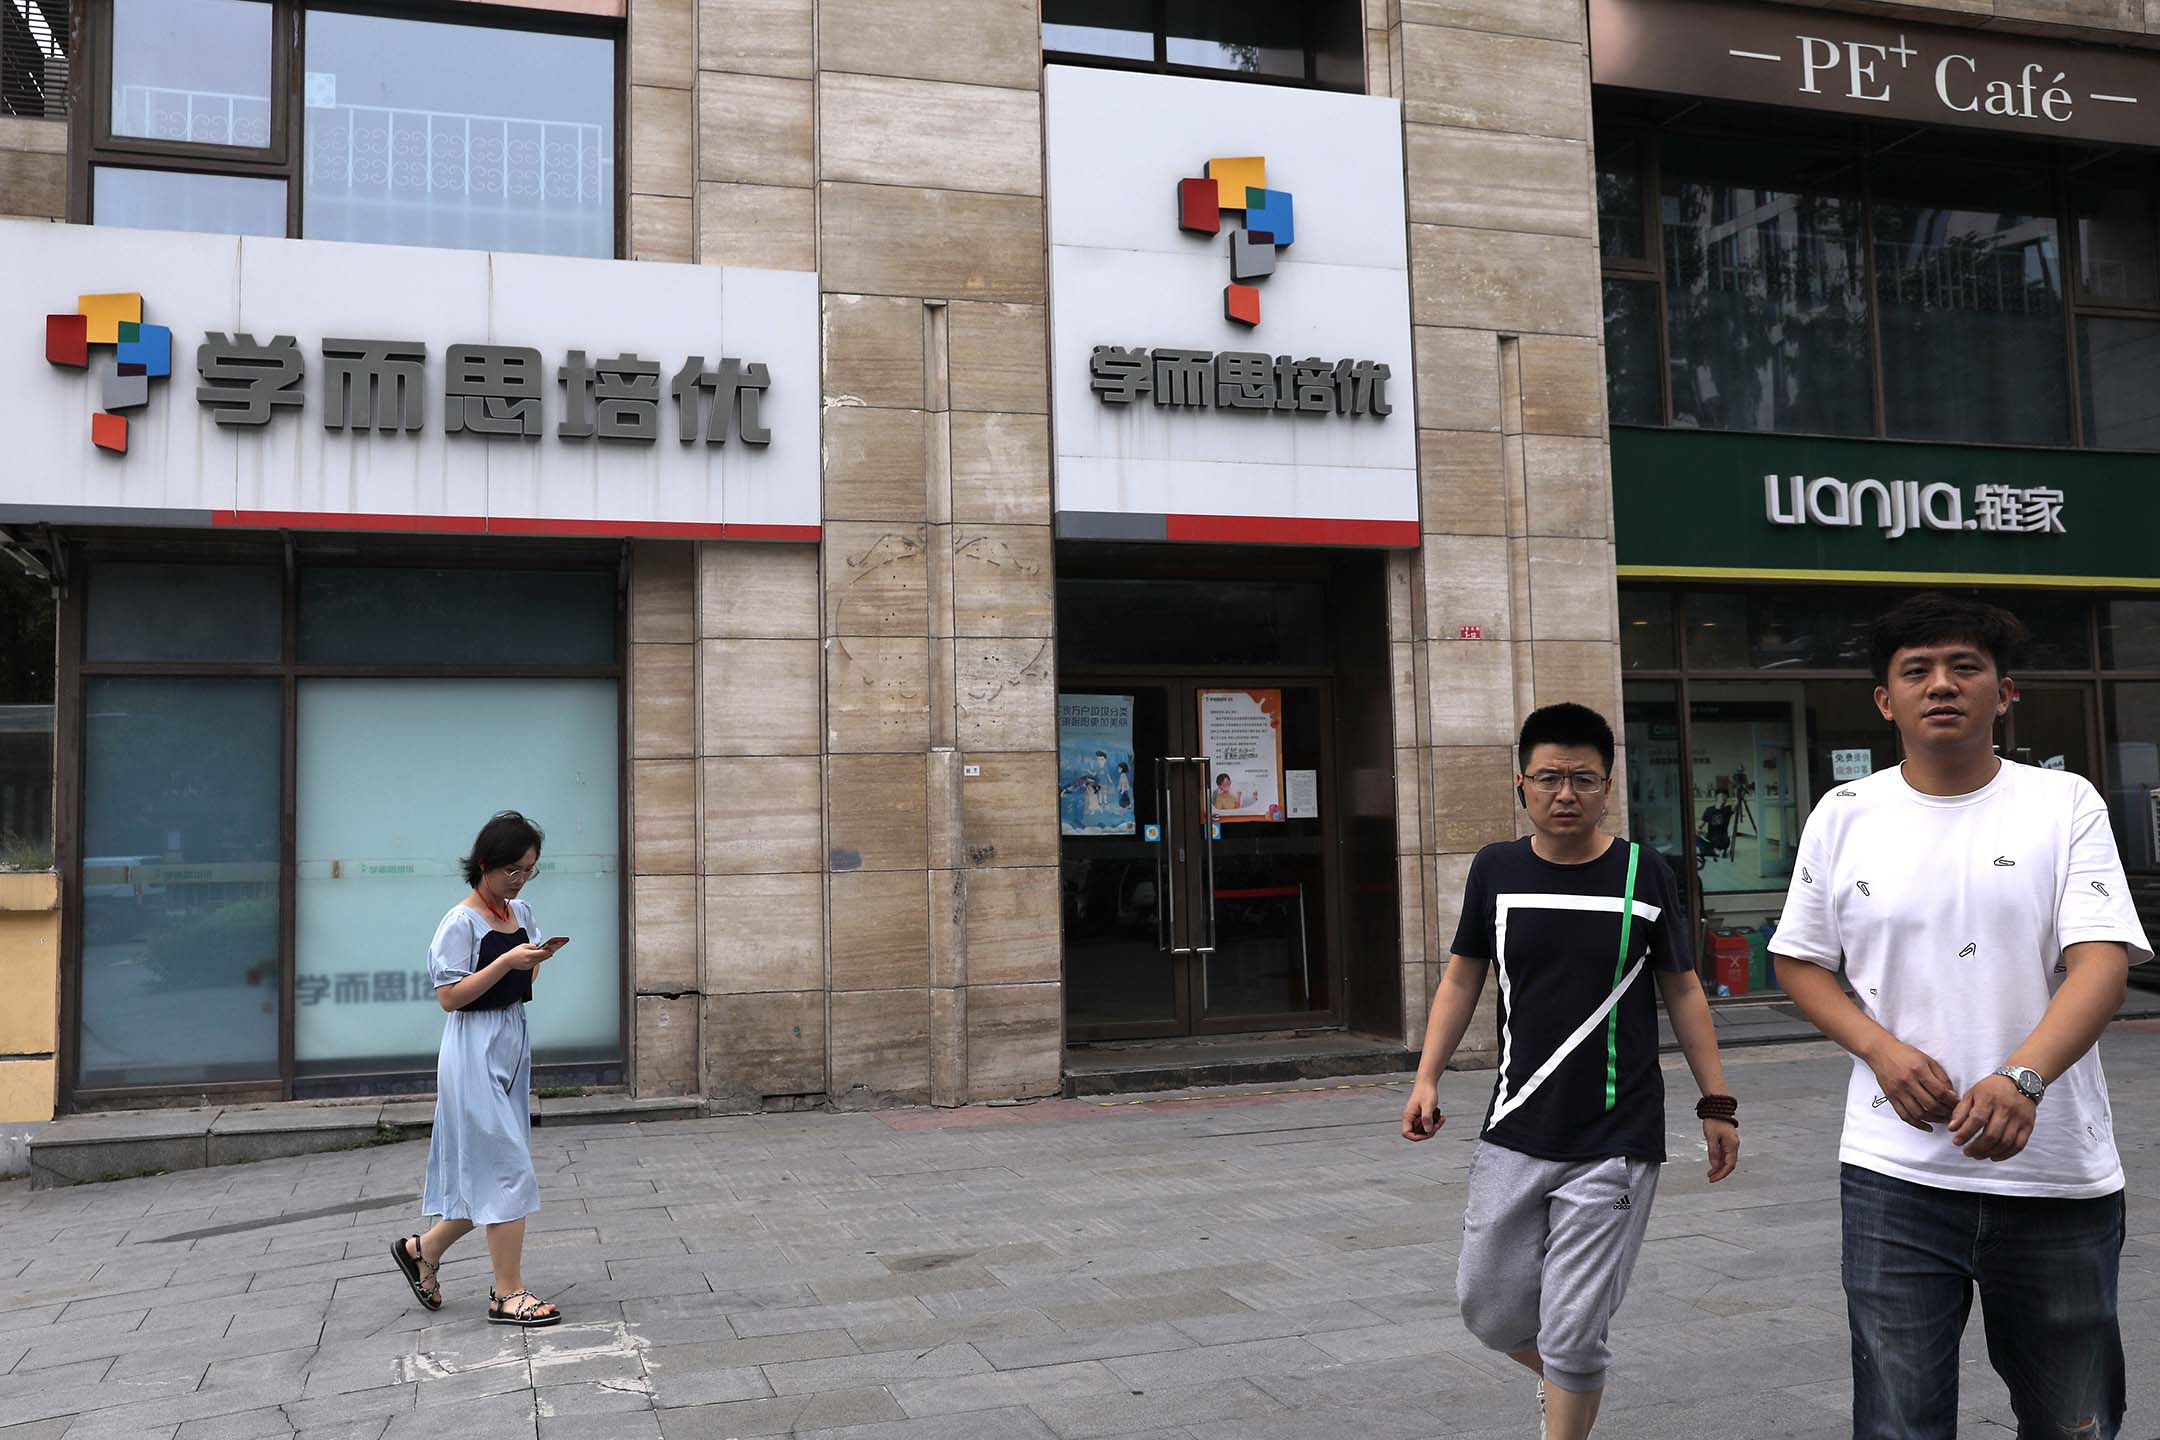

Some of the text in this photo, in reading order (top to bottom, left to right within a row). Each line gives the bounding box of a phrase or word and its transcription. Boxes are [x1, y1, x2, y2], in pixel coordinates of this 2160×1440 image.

[1935, 53, 2074, 122] Café
[196, 331, 772, 446] 学而思培优
[1090, 345, 1393, 416] 学而思培优
[1975, 483, 2067, 533] 链家
